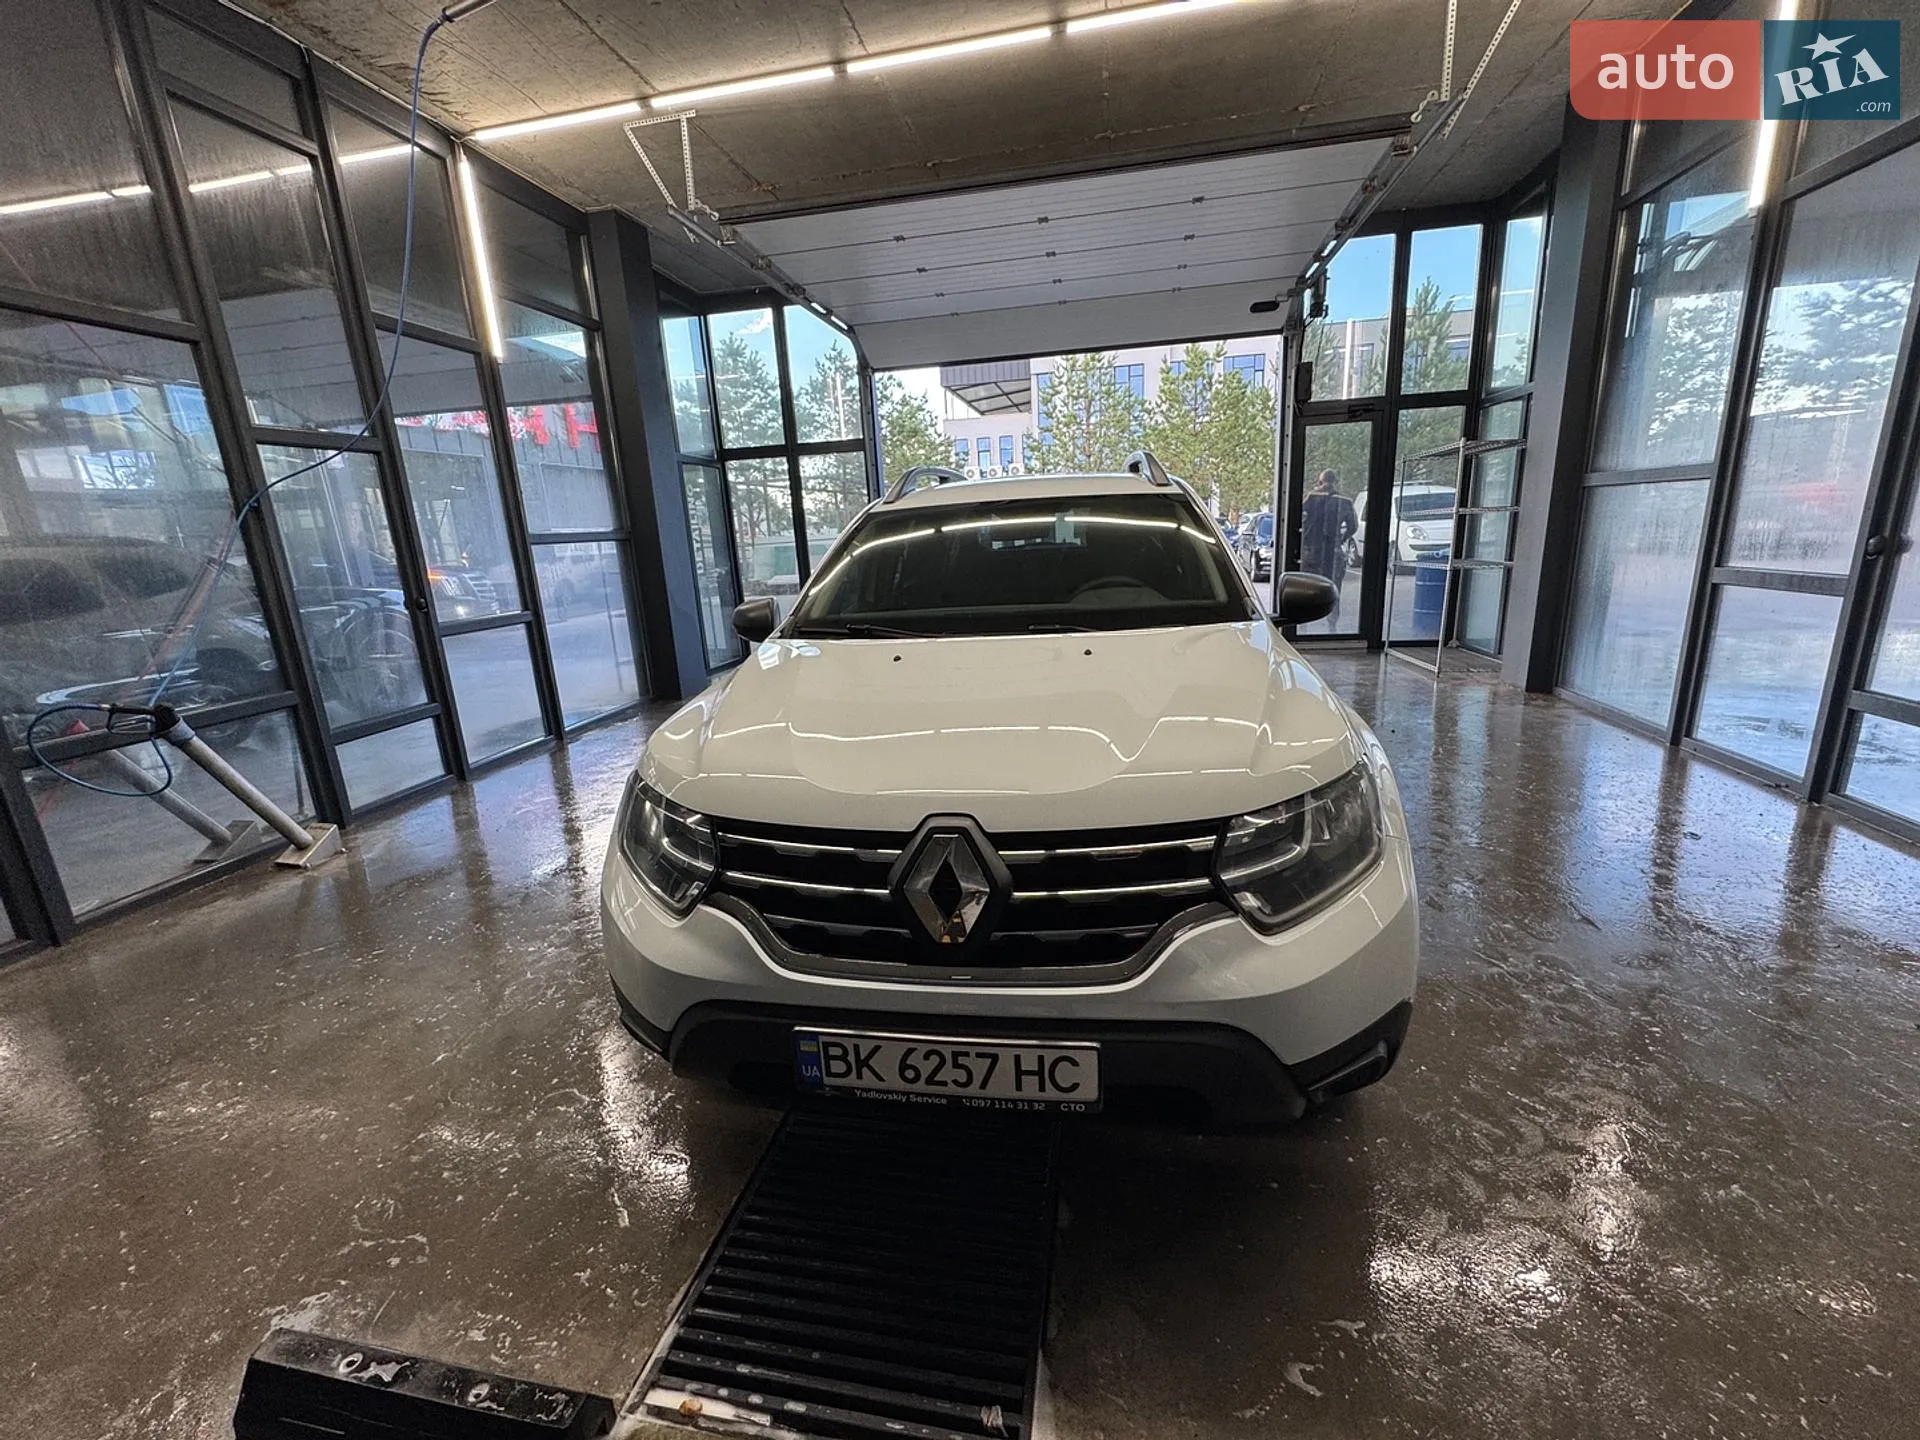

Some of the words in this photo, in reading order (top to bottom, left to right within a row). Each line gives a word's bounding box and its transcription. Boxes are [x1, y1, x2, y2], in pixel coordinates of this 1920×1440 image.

[801, 1064, 820, 1078] UA
[821, 1041, 886, 1083] BK
[898, 1048, 1000, 1091] 6257
[1013, 1054, 1081, 1094] HC
[854, 1089, 907, 1103] Yadlovskiy
[909, 1094, 948, 1105] Service
[972, 1099, 991, 1108] 097
